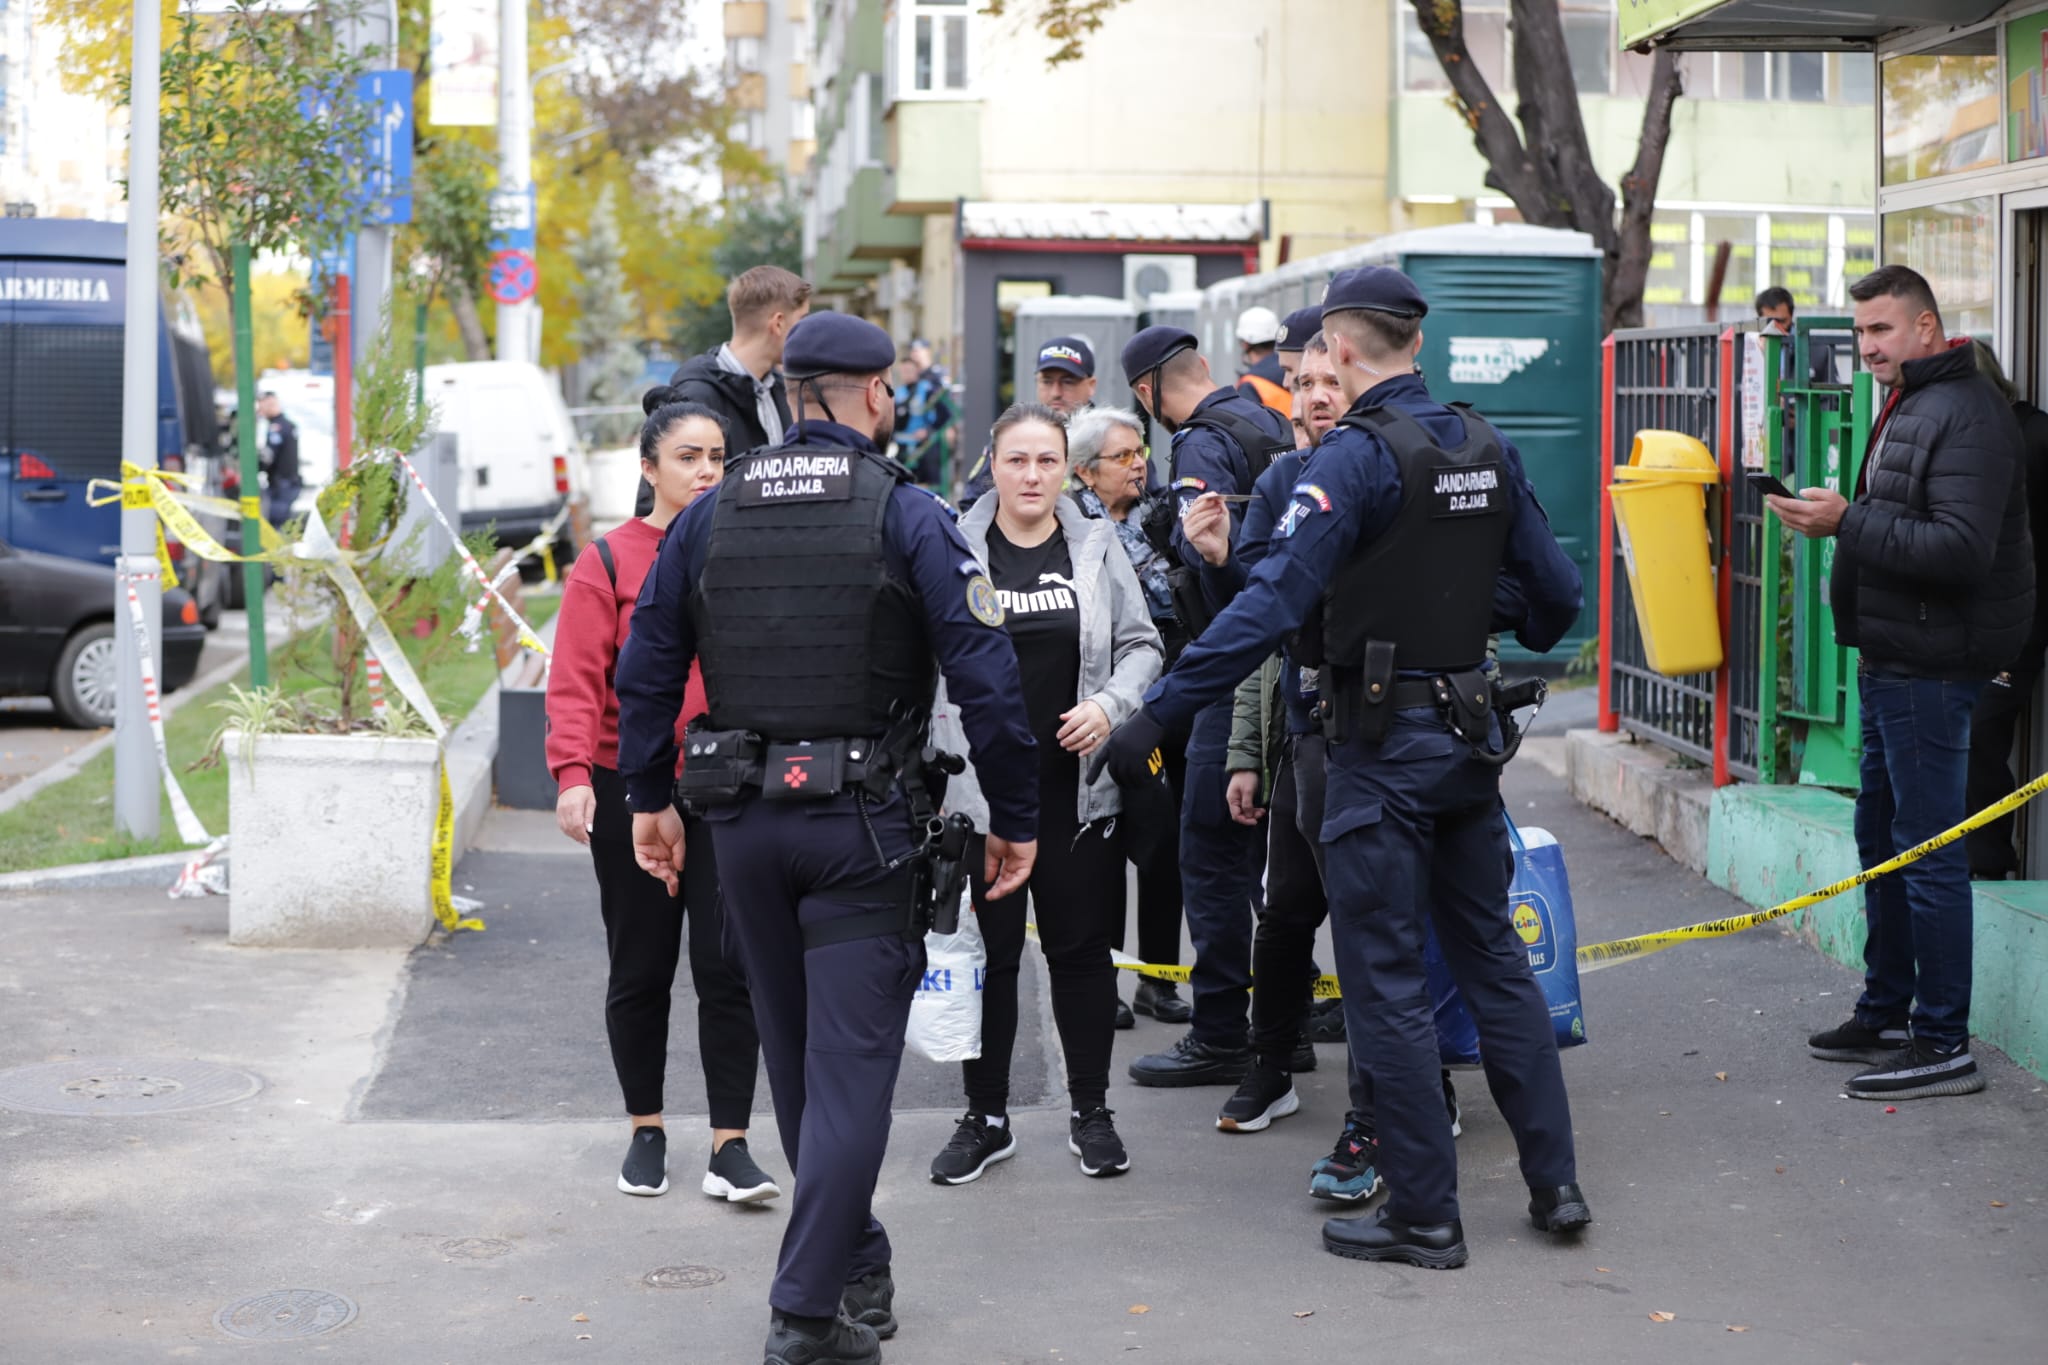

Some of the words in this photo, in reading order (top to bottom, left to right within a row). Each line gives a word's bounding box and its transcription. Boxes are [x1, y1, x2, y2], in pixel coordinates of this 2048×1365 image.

[744, 456, 850, 481] JANDARMERIA
[761, 479, 825, 497] D.G.J.M.B.
[1434, 469, 1498, 494] JANDARMERIA
[996, 588, 1075, 614] PUMA
[1528, 950, 1545, 968] lus
